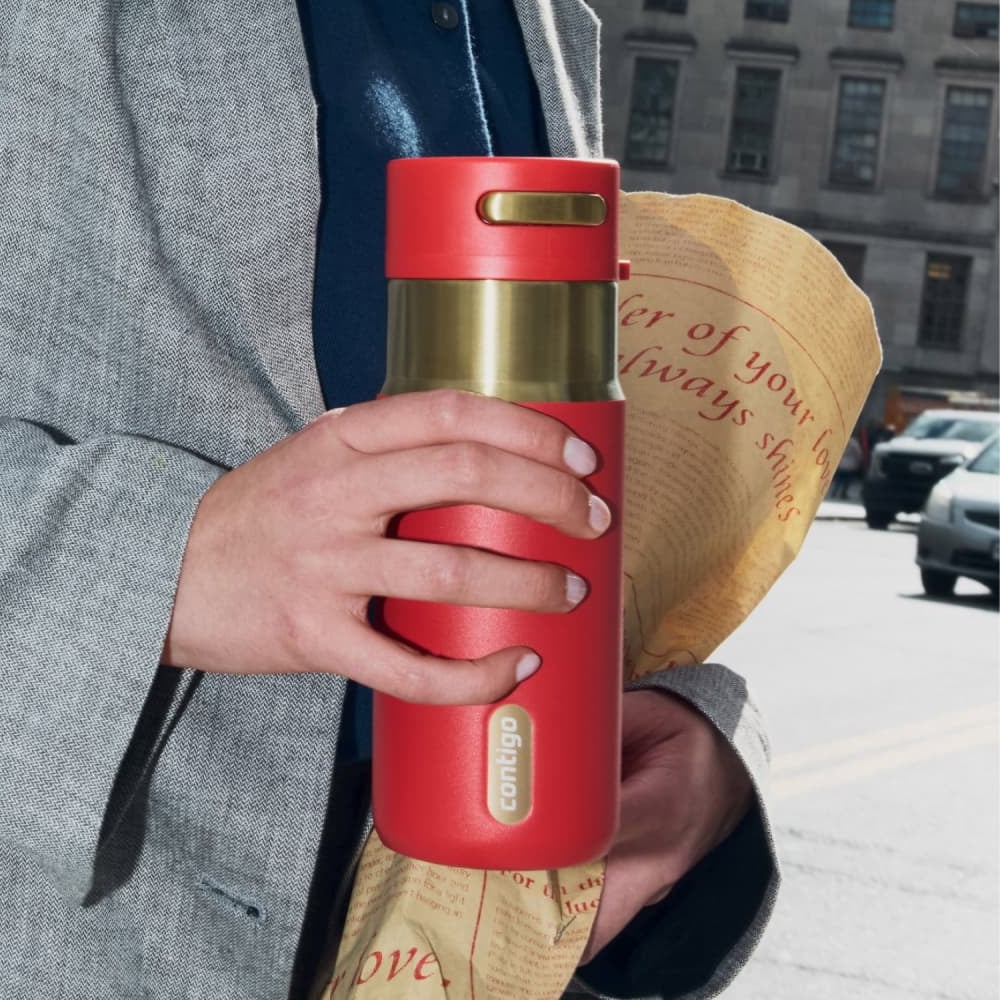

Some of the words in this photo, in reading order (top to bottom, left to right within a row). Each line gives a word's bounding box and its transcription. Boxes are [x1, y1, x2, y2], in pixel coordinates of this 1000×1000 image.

[681, 322, 751, 357] of
[733, 351, 815, 425] your
[618, 345, 755, 426] lways
[755, 432, 801, 522] shines
[496, 716, 522, 812] contigo
